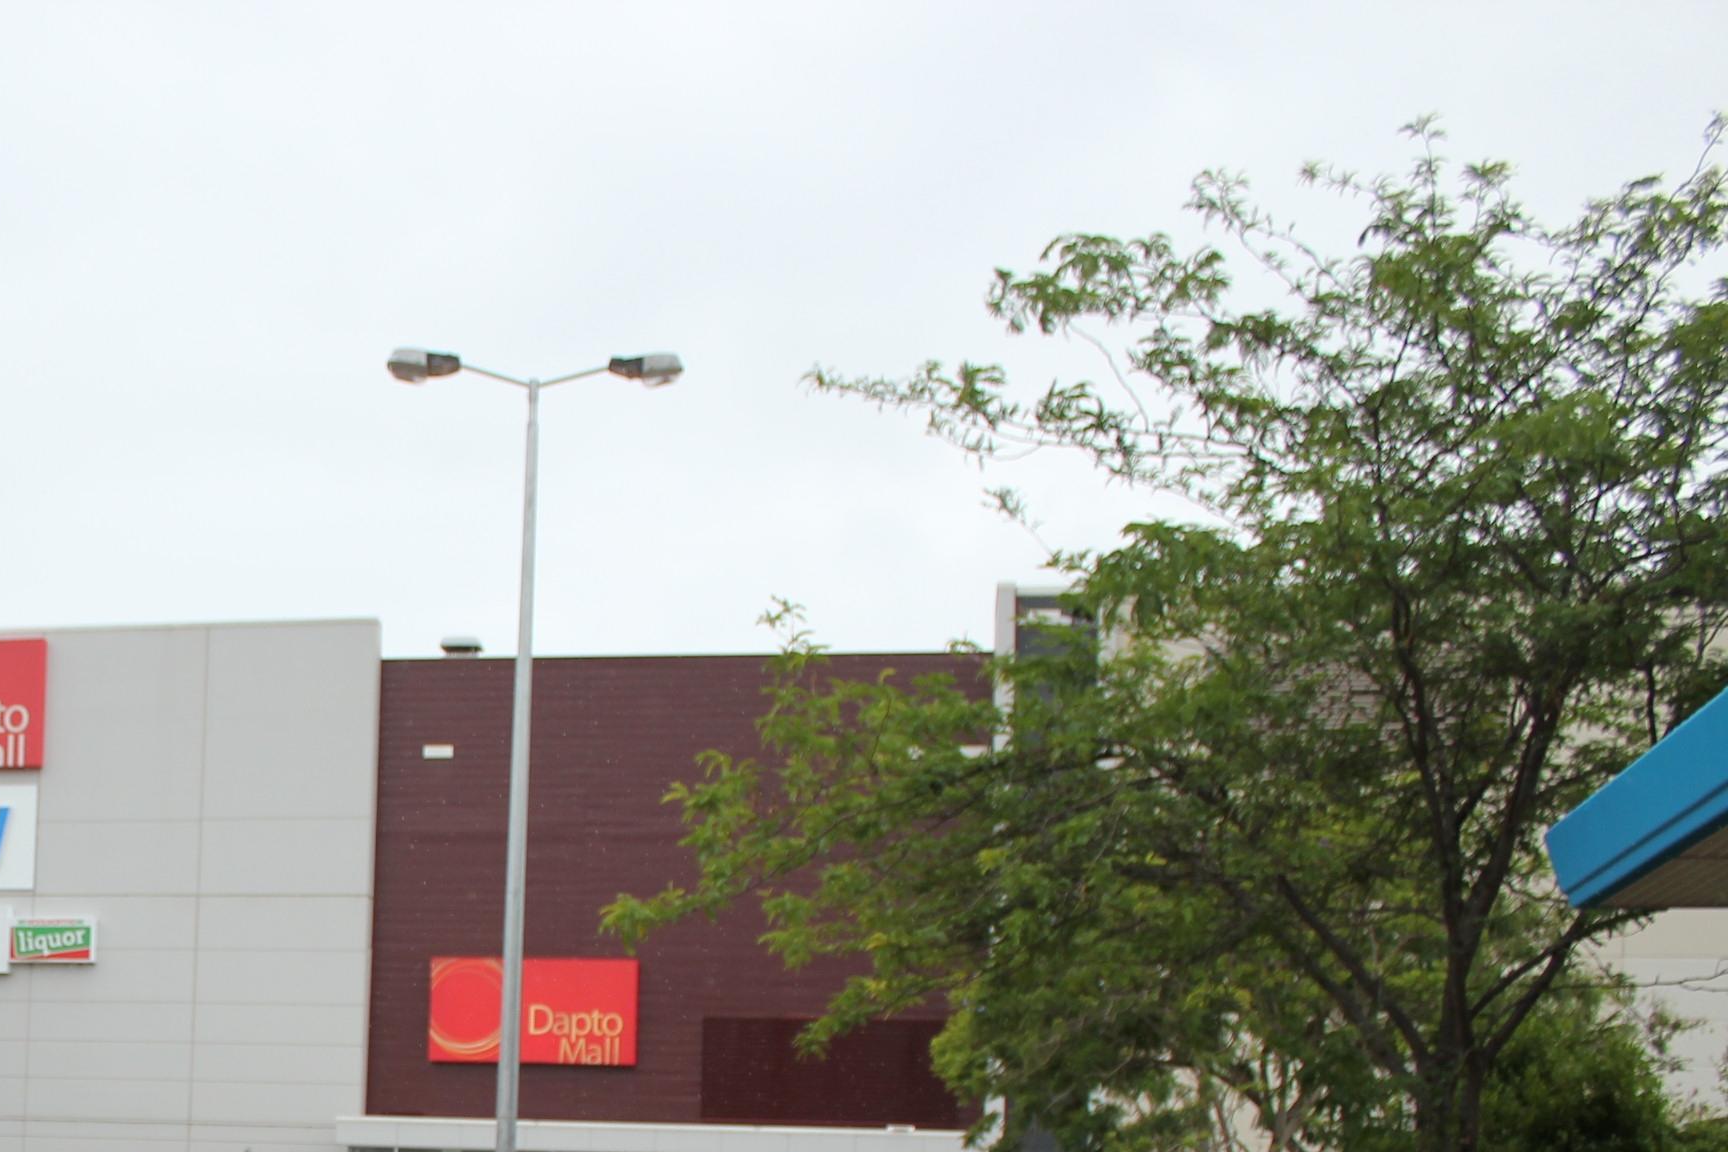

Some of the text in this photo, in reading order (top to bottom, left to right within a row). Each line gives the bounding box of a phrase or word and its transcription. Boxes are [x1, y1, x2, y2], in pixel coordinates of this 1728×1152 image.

[17, 929, 86, 957] liquor
[528, 1003, 624, 1043] Dapto
[559, 1035, 620, 1066] Mall
